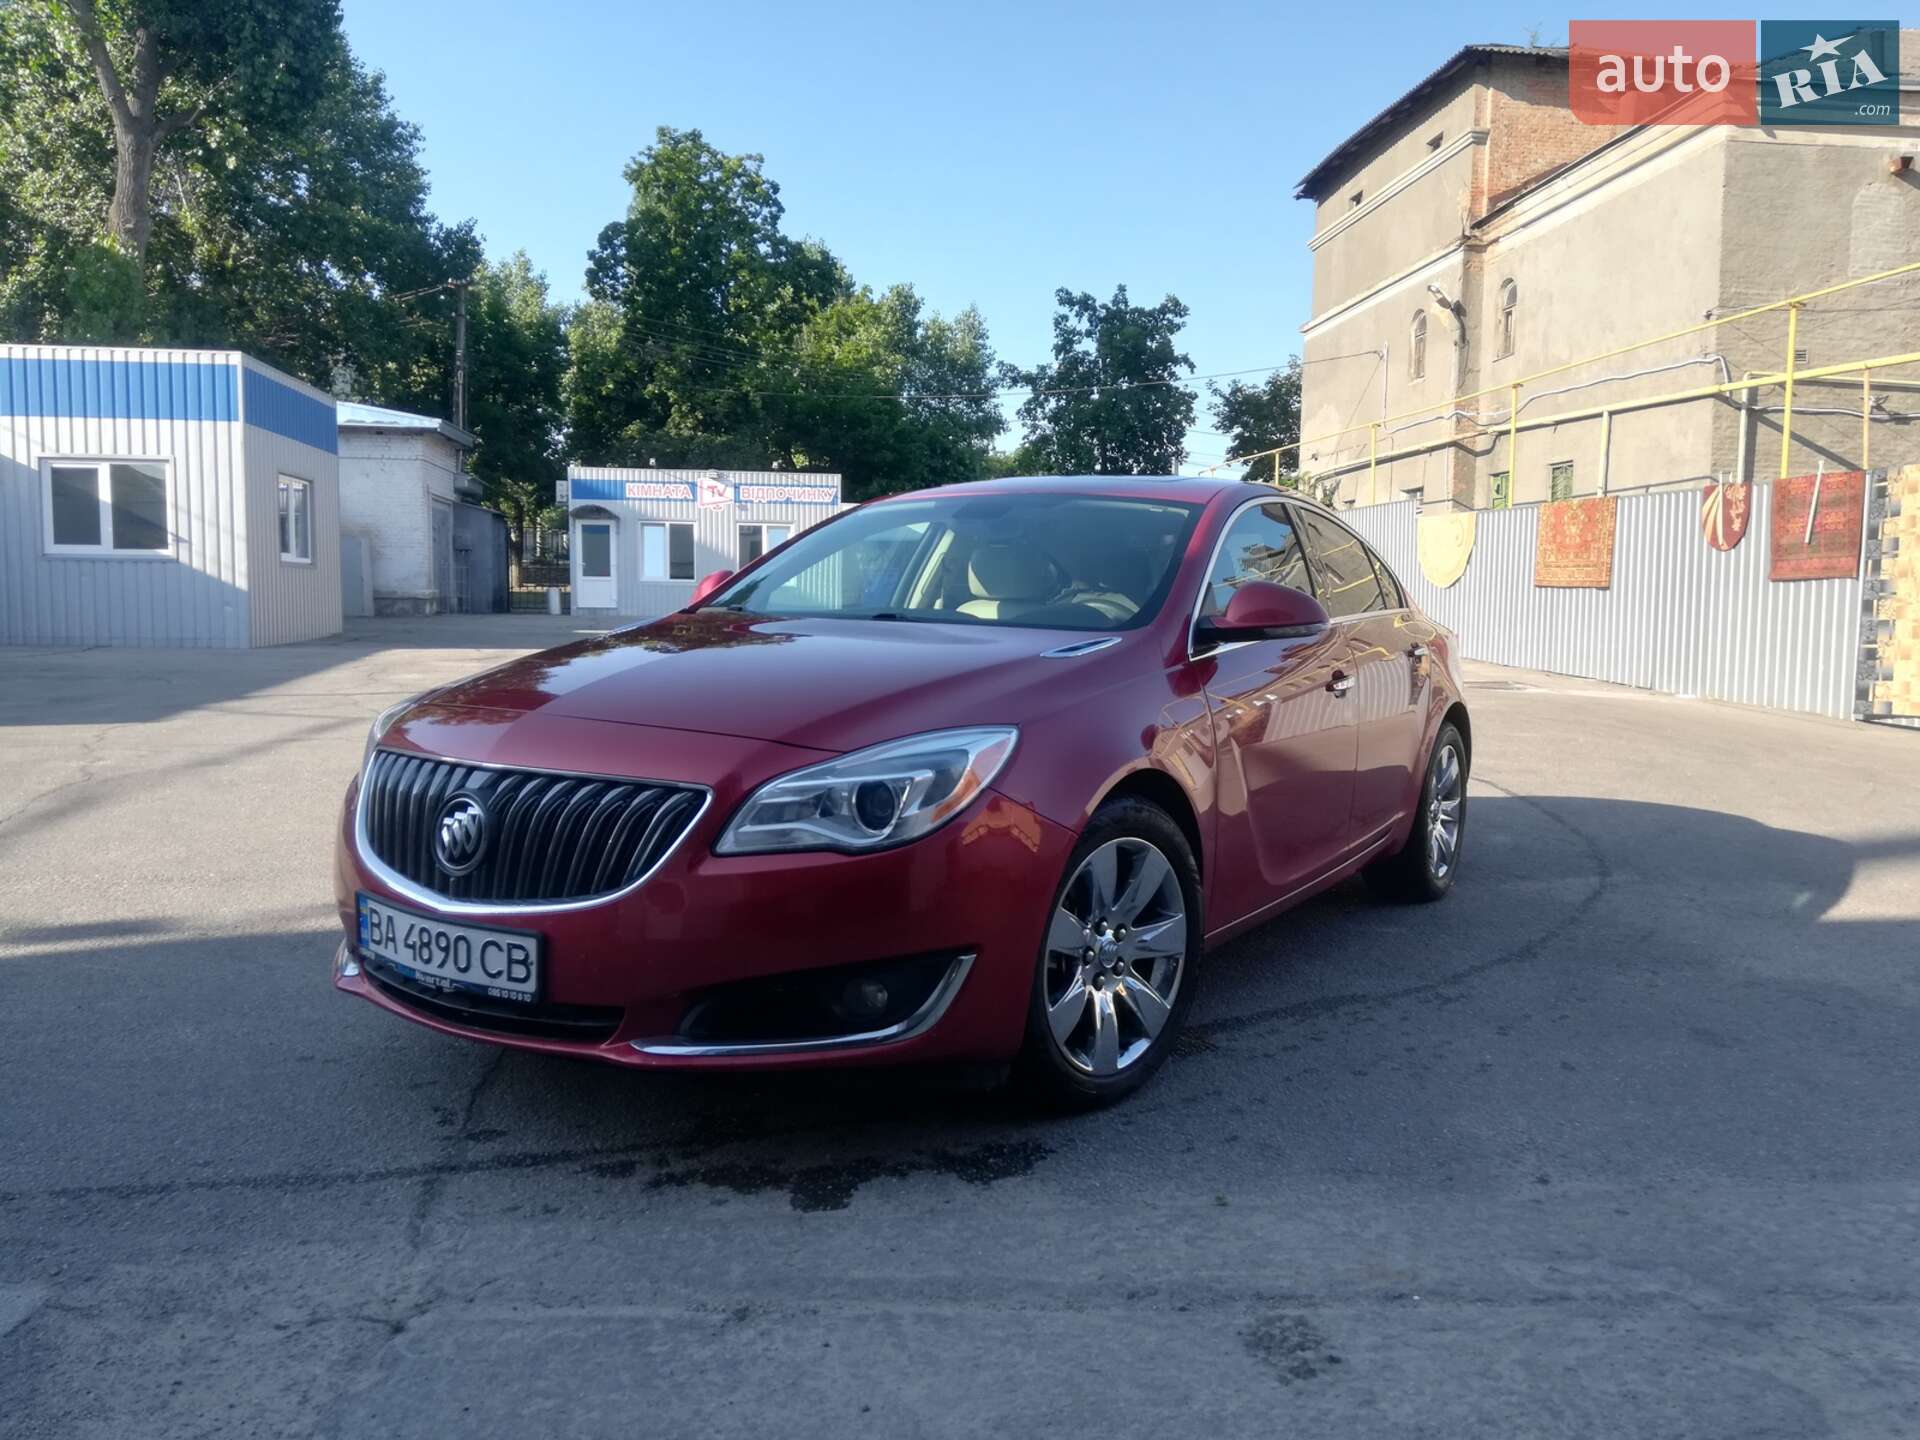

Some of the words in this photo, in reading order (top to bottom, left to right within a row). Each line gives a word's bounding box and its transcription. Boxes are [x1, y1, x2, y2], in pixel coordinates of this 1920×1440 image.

[627, 483, 692, 498] КІМНАТА
[741, 485, 837, 502] ВІДПОЧИНКУ
[369, 907, 398, 954] BA
[403, 923, 472, 974] 4890
[480, 938, 532, 984] CB
